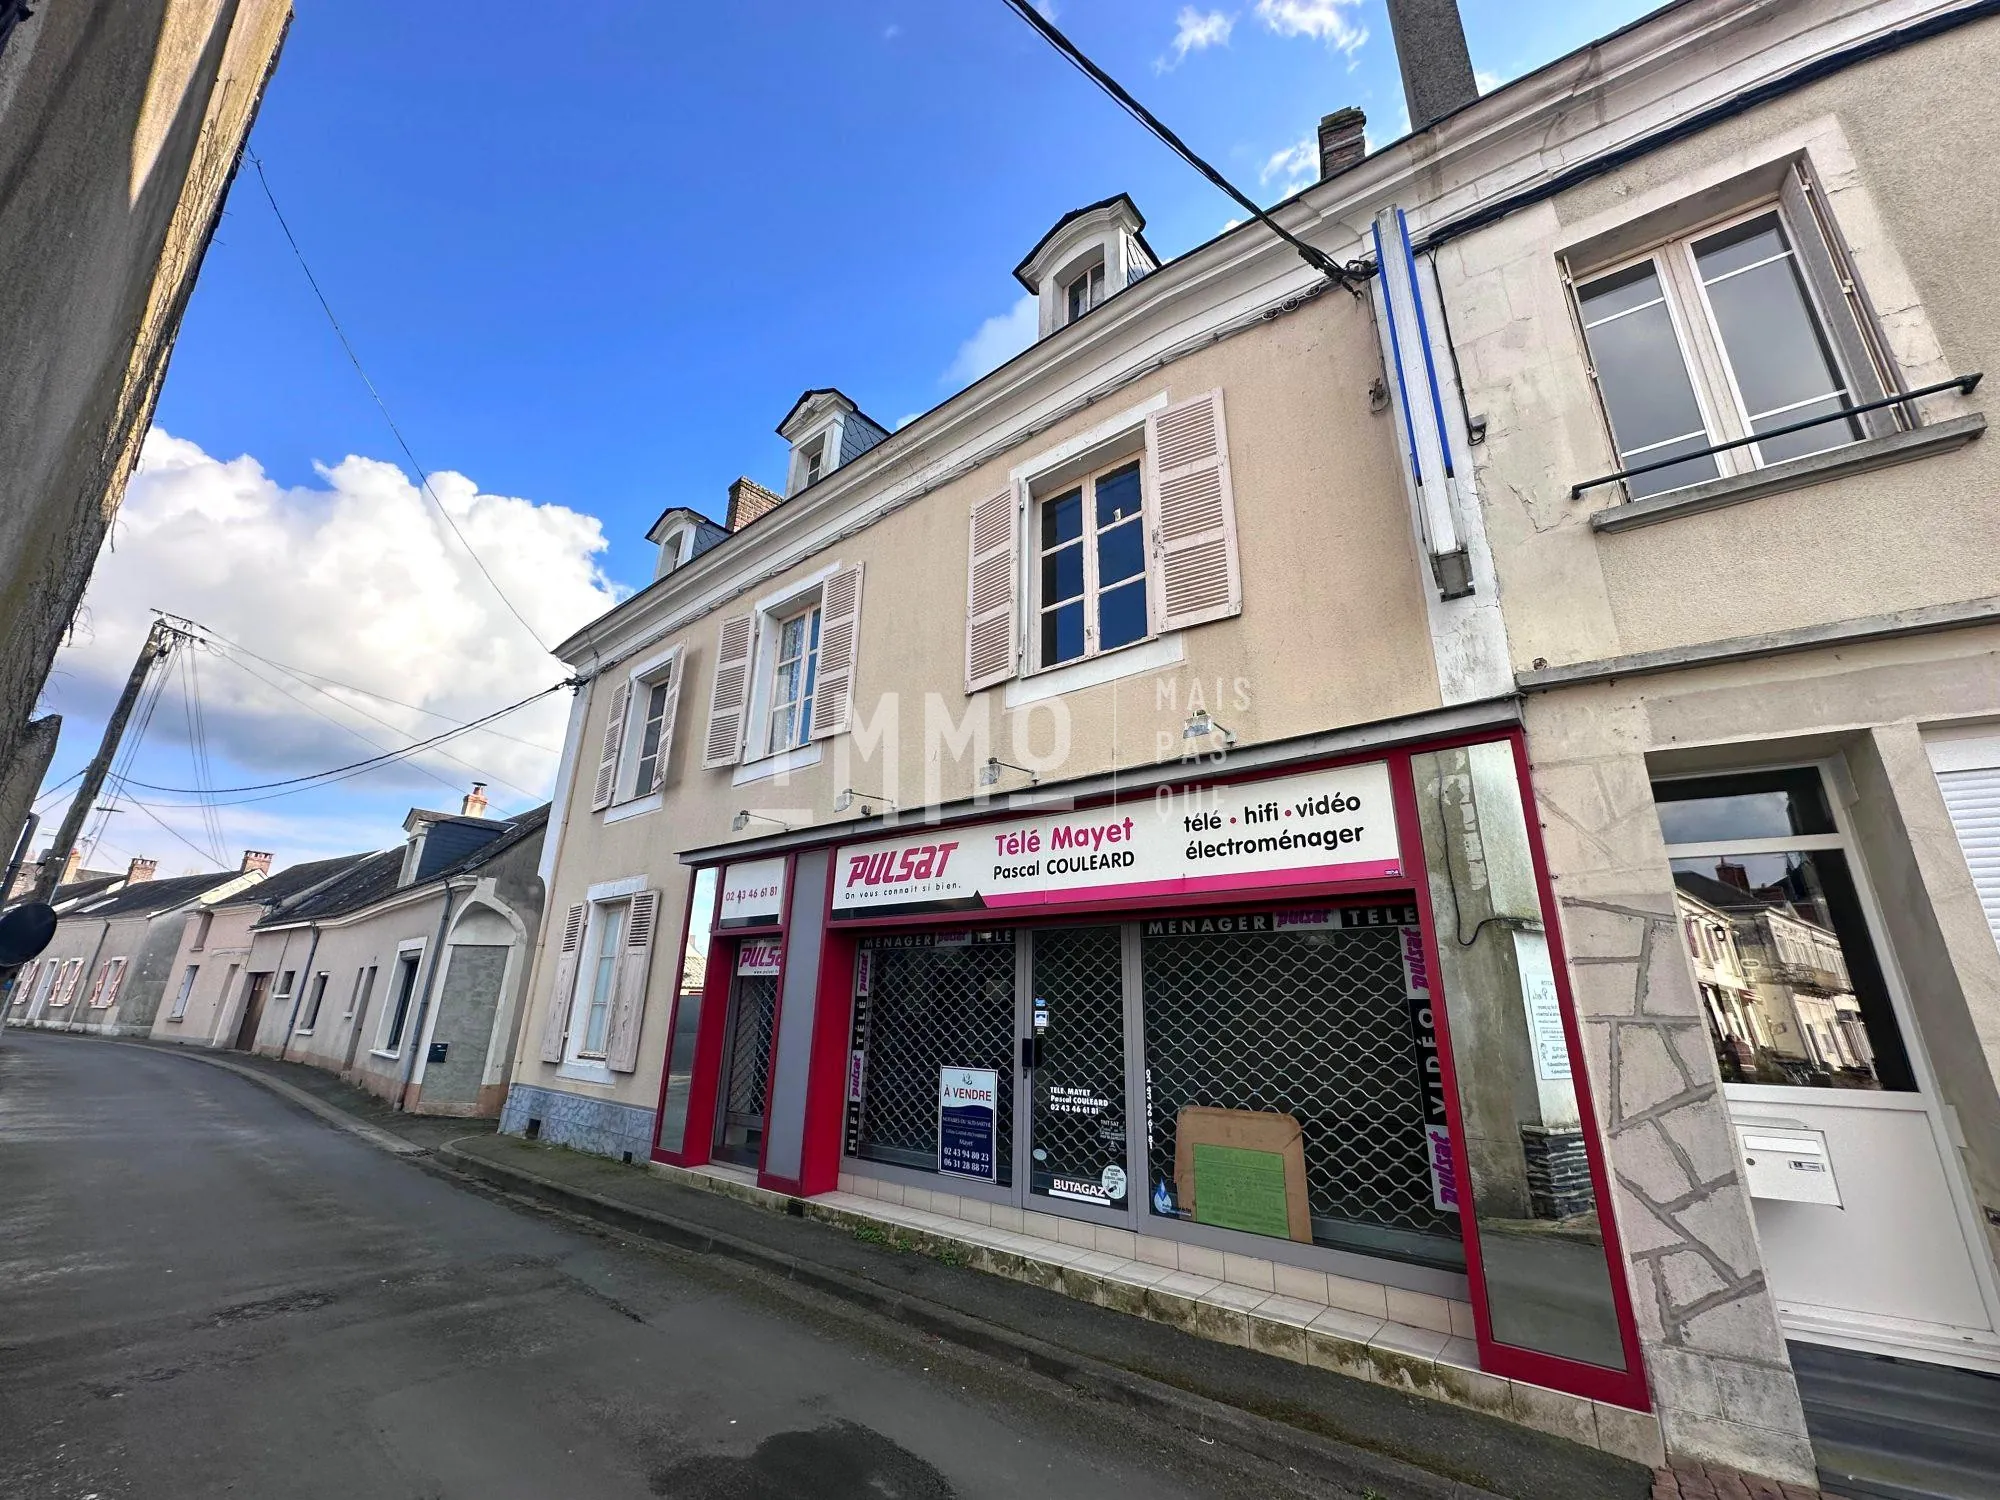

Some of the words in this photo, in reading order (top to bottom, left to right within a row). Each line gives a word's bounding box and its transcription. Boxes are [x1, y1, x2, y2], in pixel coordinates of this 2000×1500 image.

[1183, 810, 1222, 833] télé
[1244, 802, 1279, 824] hifi
[1296, 792, 1361, 818] vidéo
[995, 829, 1041, 857] Télé
[1051, 816, 1134, 852] Mayet
[1185, 826, 1364, 860] électroménager
[993, 860, 1040, 880] Pascal
[1046, 851, 1135, 876] COULEARD
[726, 891, 735, 901] 02
[737, 889, 746, 900] 43
[748, 888, 758, 898] 46
[760, 887, 768, 897] 61
[769, 886, 778, 897] 81
[845, 892, 855, 900] On
[922, 883, 931, 892] si
[856, 1000, 867, 1045] TÉLÉ
[1416, 1008, 1446, 1115] VIDÉO
[944, 1084, 951, 1098] À
[953, 1087, 992, 1102] VENDRE
[1050, 1095, 1072, 1103] Pascal
[1073, 1096, 1109, 1107] COULEARD
[1067, 1088, 1091, 1096] MAYET
[1061, 1104, 1070, 1112] 43
[1072, 1105, 1081, 1113] 46
[1091, 1107, 1099, 1115] 81
[848, 1106, 859, 1151] HIFI
[943, 1147, 952, 1155] 02
[952, 1148, 961, 1157] 43
[962, 1149, 970, 1158] 94
[971, 1151, 980, 1160] 80
[981, 1152, 989, 1162] 23
[943, 1157, 952, 1167] 06
[952, 1159, 960, 1168] 31
[962, 1160, 970, 1170] 28
[981, 1164, 990, 1173] 77
[1053, 1178, 1106, 1198] BUTAGAZ
